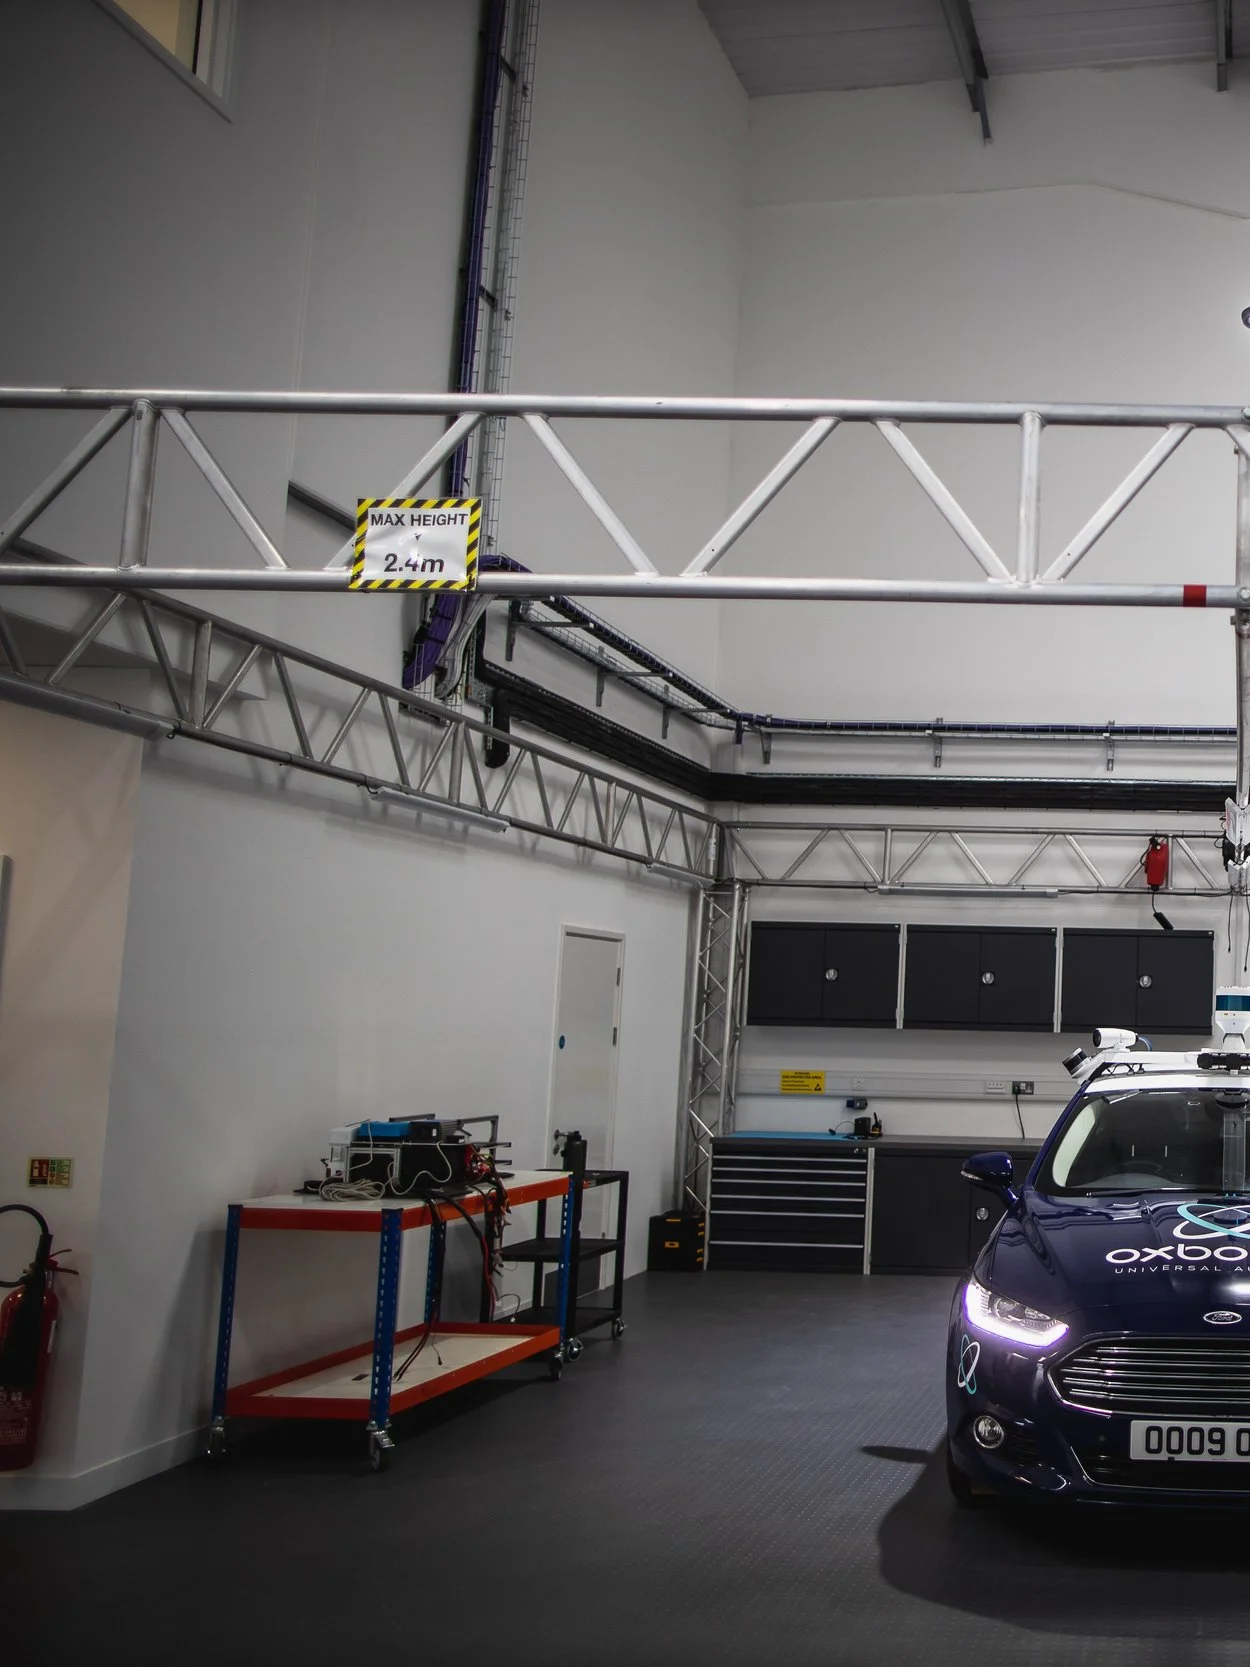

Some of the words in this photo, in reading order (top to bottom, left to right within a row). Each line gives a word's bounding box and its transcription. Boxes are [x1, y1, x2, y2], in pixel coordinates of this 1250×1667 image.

[370, 513, 406, 527] MAX
[410, 513, 469, 527] HEIGHT
[383, 553, 445, 573] 2.4m
[1114, 1264, 1222, 1274] UNIVERSAL
